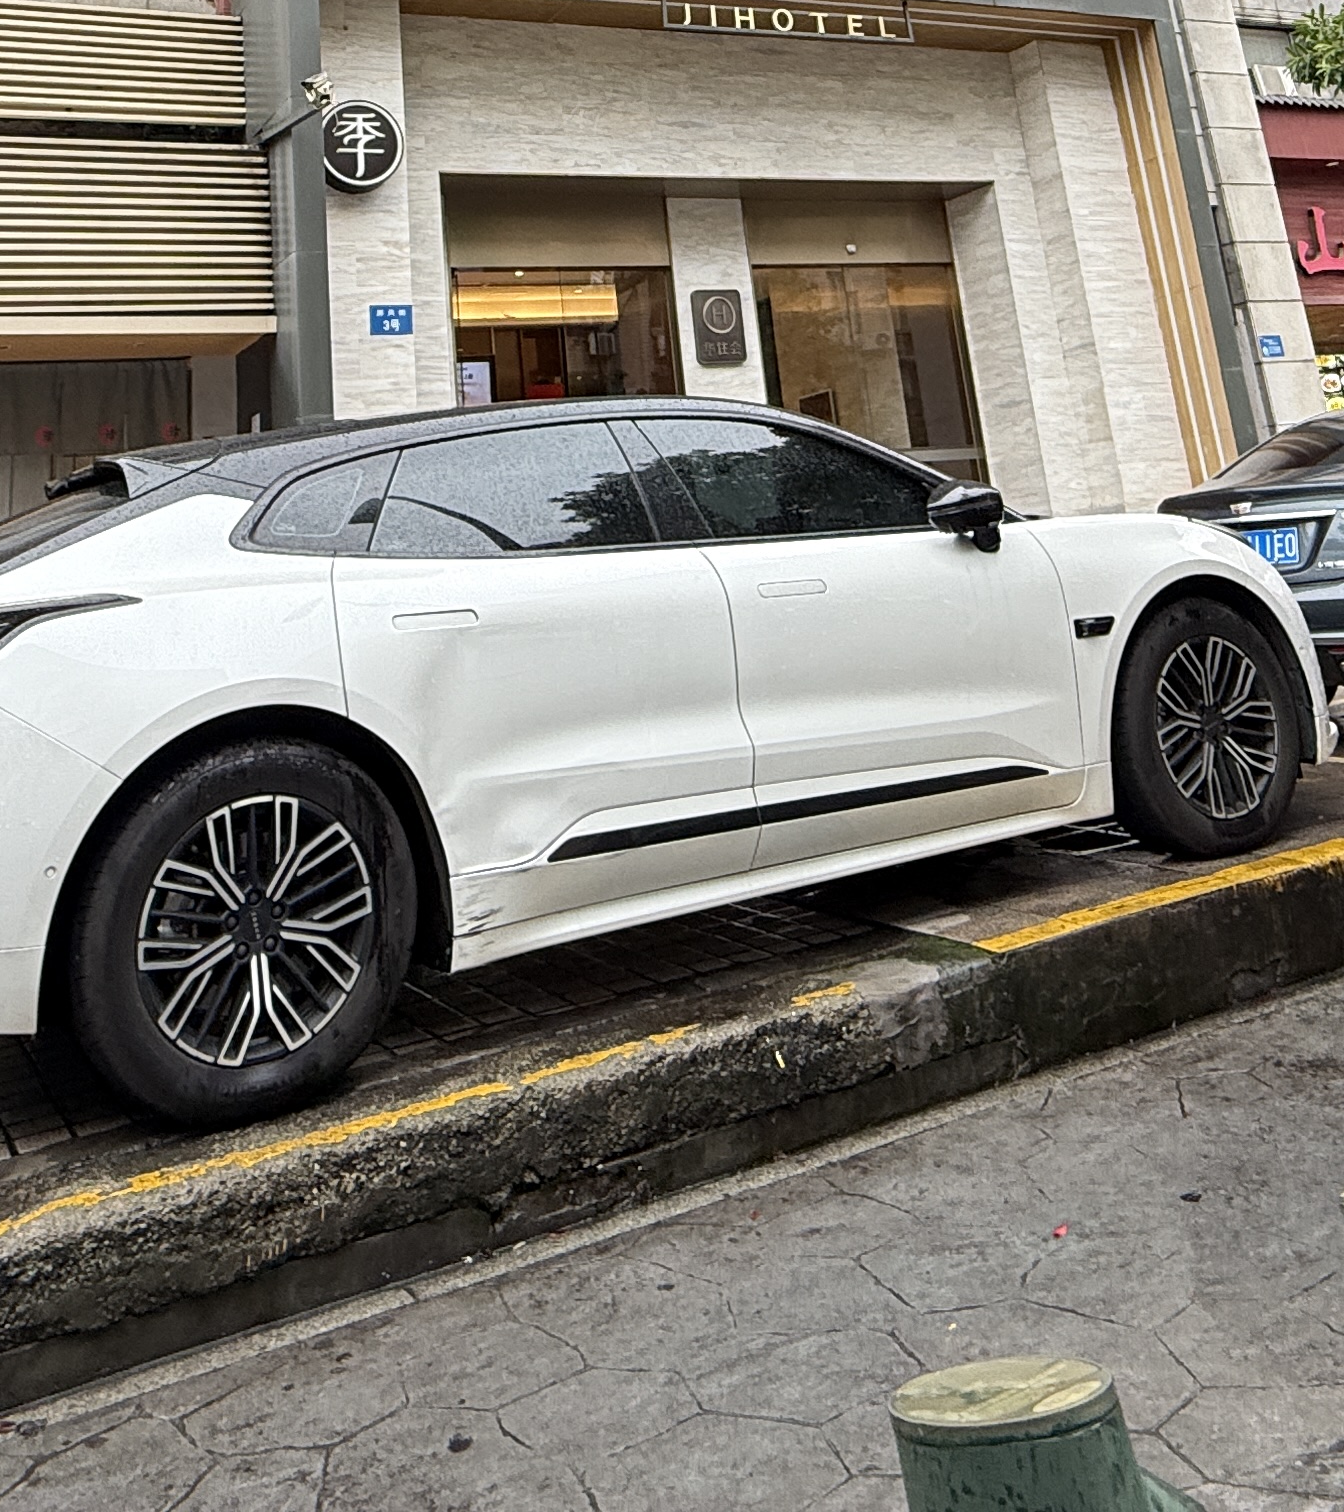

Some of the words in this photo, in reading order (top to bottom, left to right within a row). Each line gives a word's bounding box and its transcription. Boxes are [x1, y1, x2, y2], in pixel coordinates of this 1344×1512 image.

[682, 2, 898, 39] JIHOTEL
[332, 112, 386, 177] 季
[383, 318, 401, 332] 3号
[703, 340, 743, 357] 华住会
